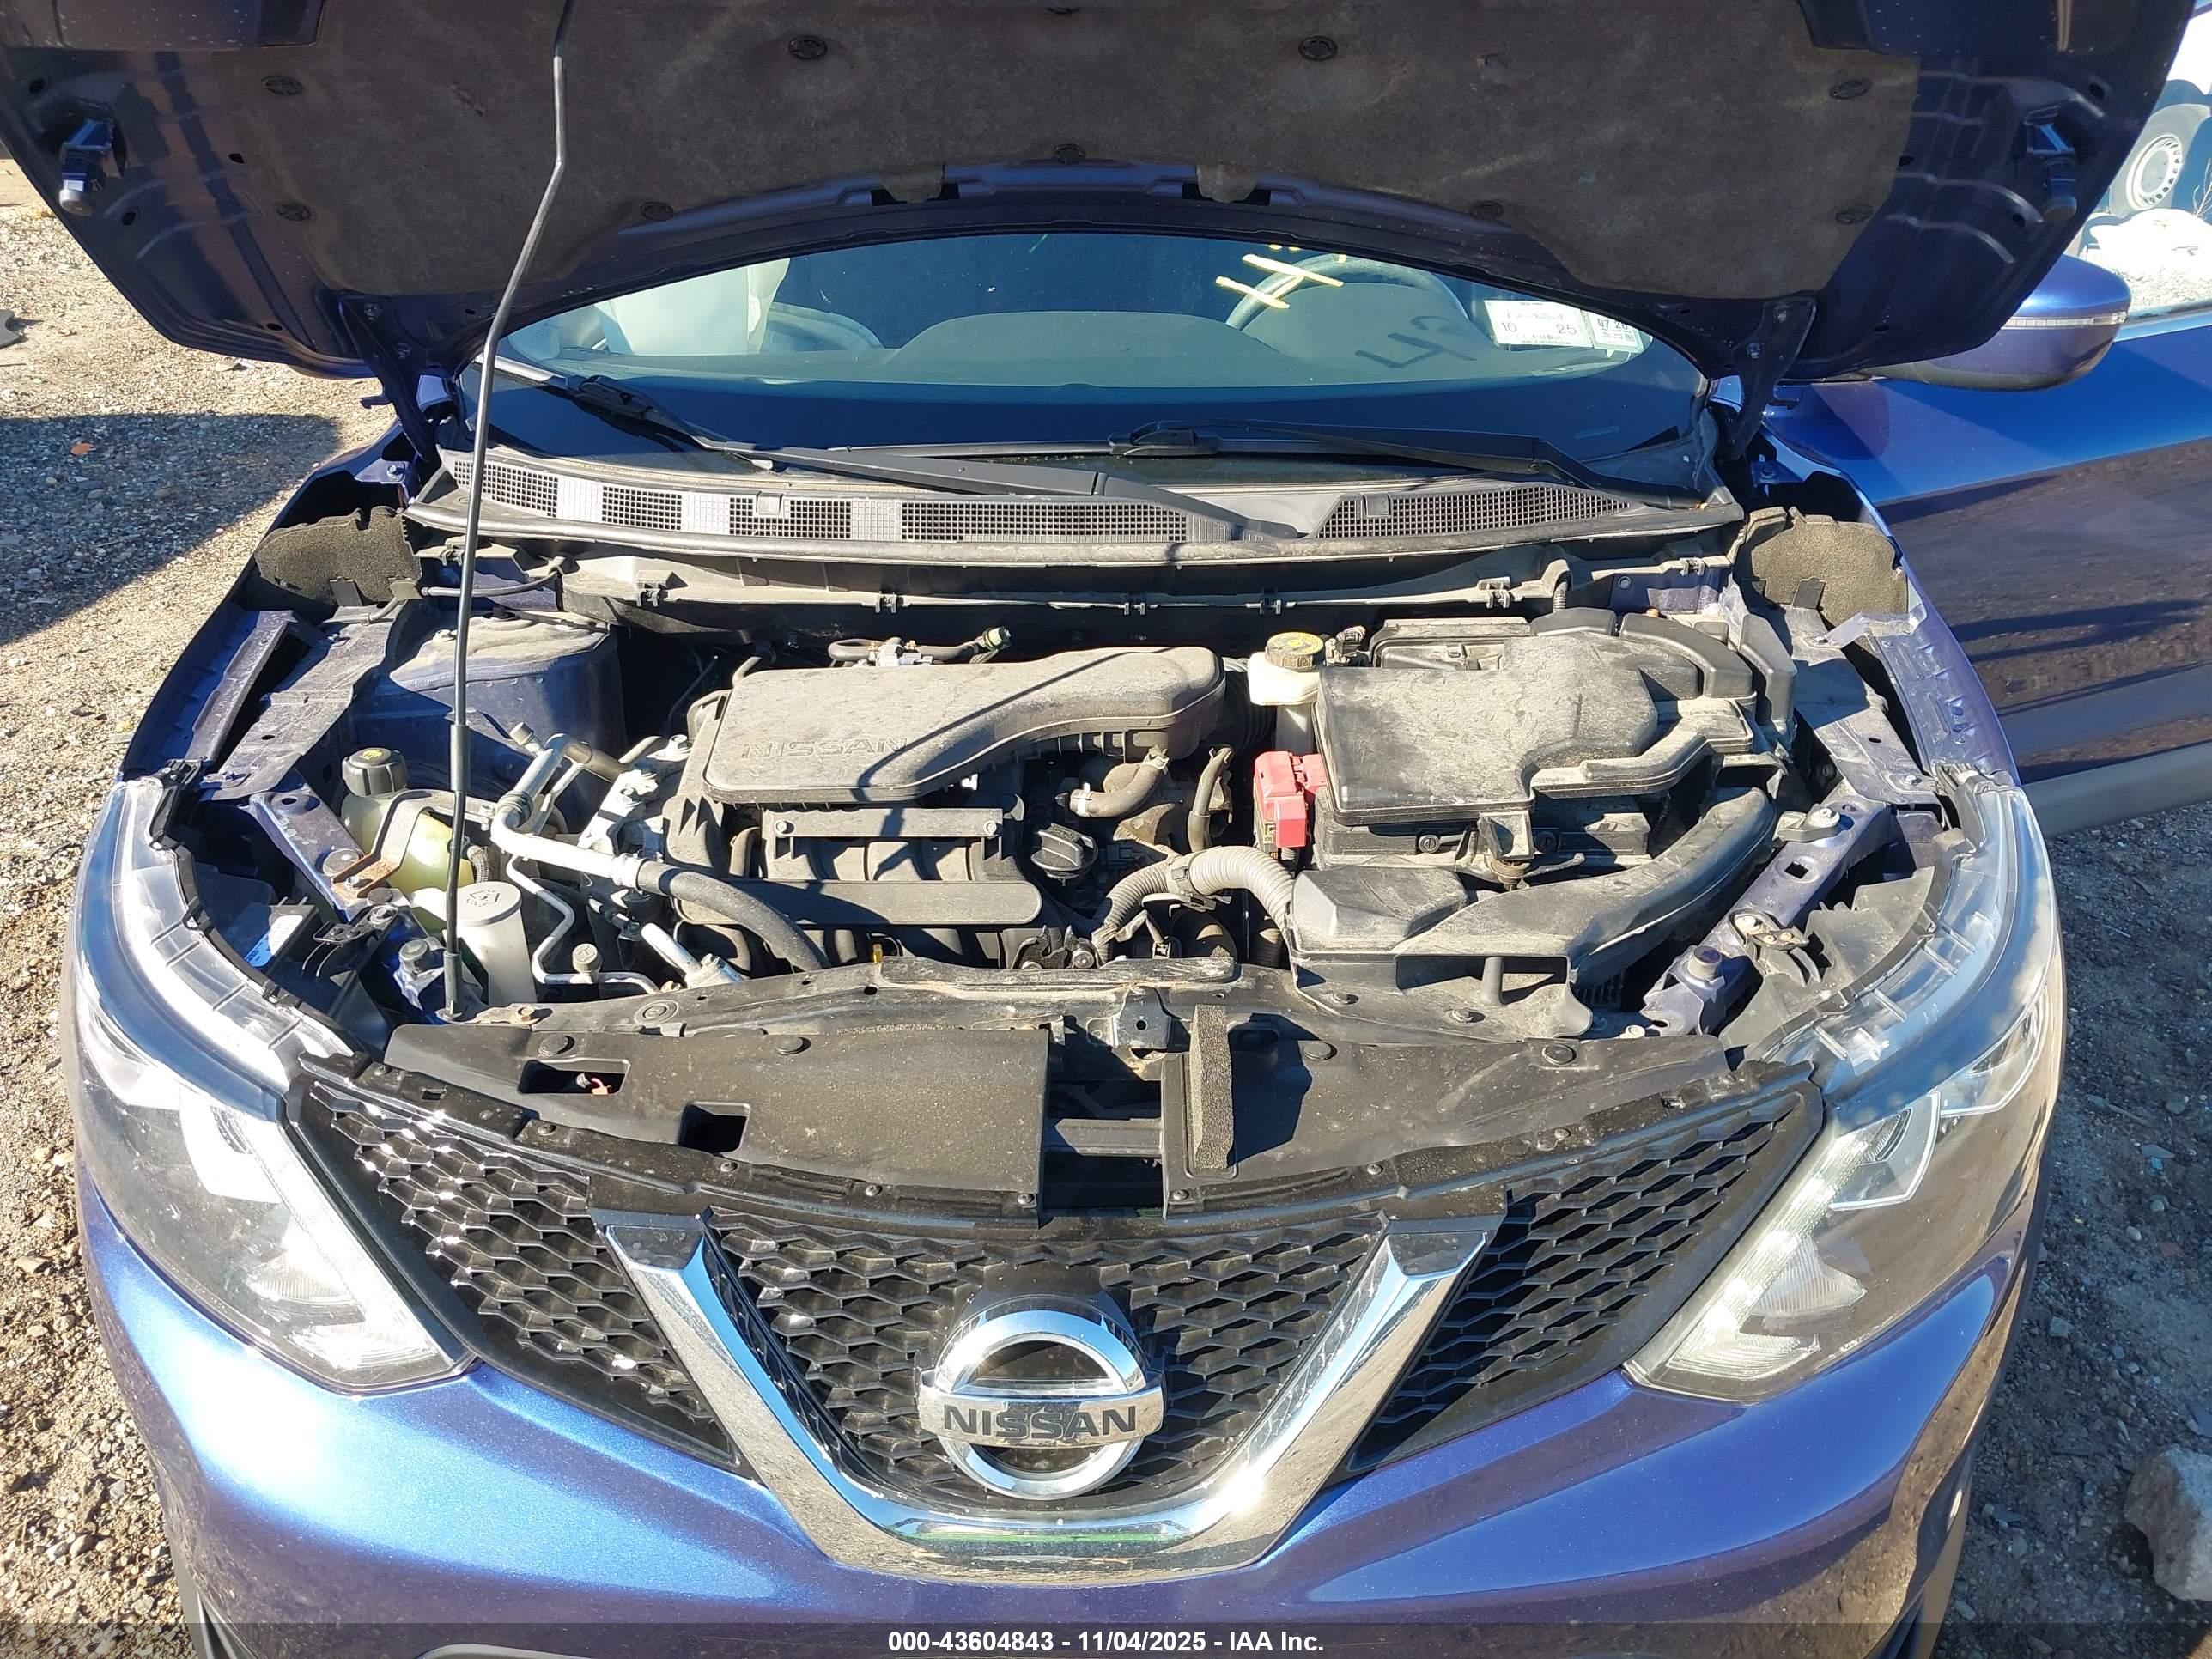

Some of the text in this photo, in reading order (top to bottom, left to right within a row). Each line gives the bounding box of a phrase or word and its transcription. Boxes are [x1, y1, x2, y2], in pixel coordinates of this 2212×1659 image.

[1501, 321, 1577, 335] 10 25
[1597, 318, 1609, 329] 07
[741, 737, 908, 758] NISSAN
[944, 1403, 1136, 1440] NISSAN
